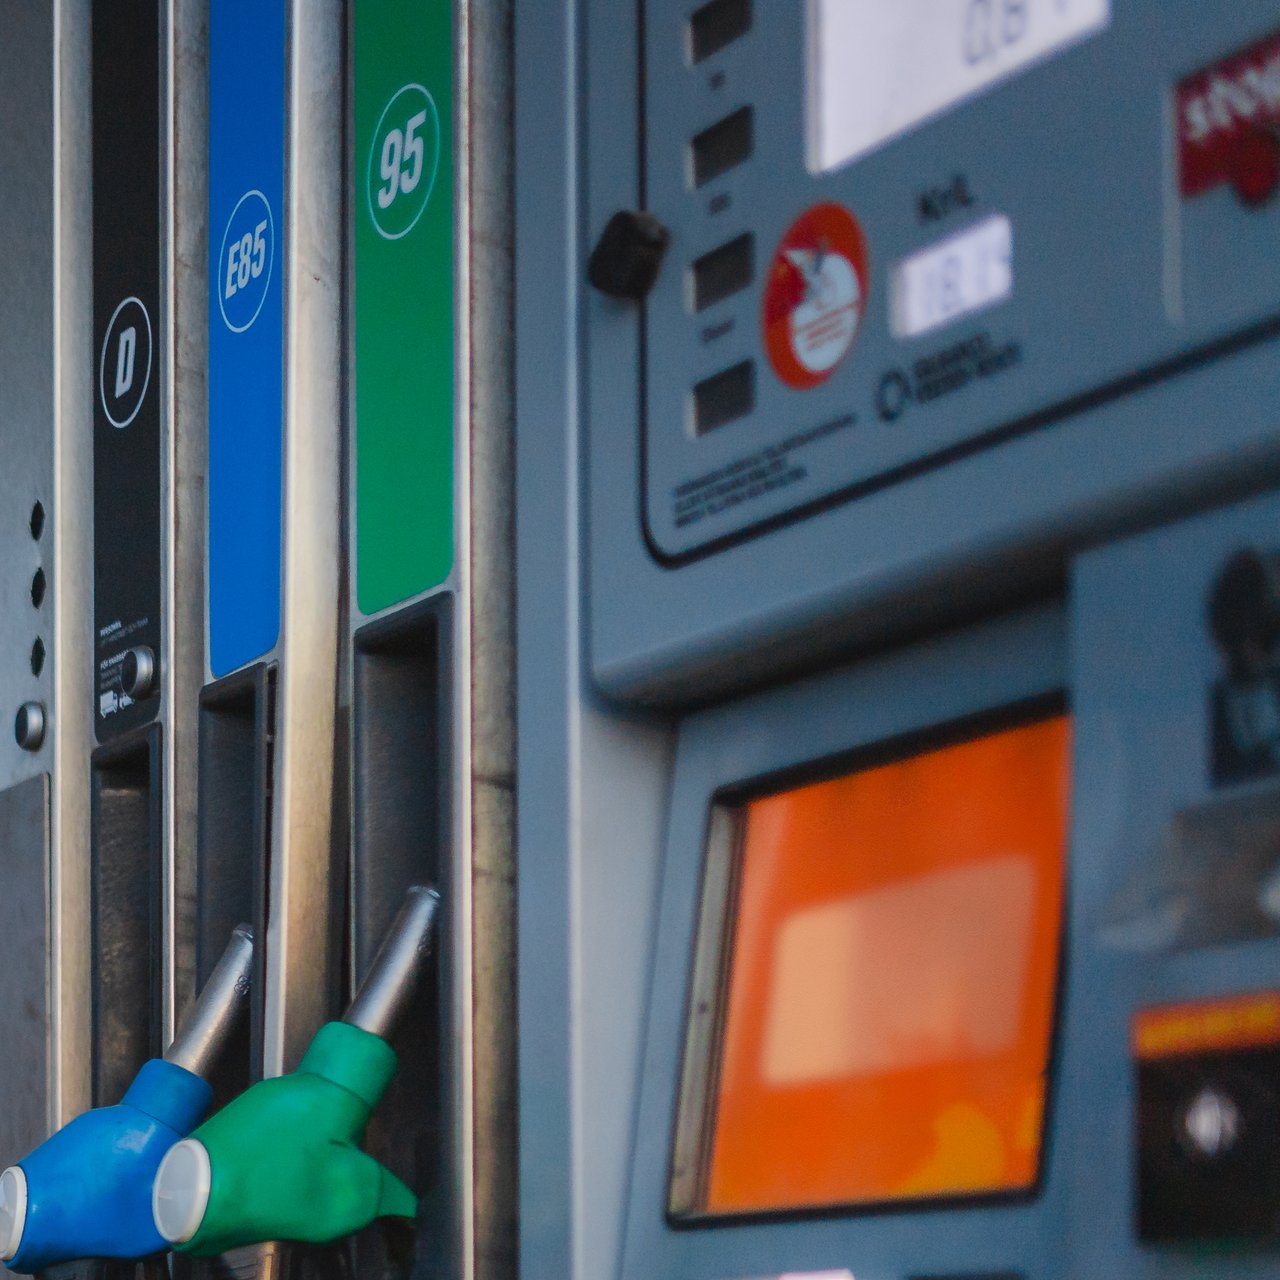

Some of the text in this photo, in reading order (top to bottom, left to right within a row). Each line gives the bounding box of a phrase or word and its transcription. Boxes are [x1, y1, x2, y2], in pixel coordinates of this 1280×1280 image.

[377, 110, 427, 209] 95
[225, 219, 268, 300] E85
[114, 326, 137, 399] D
